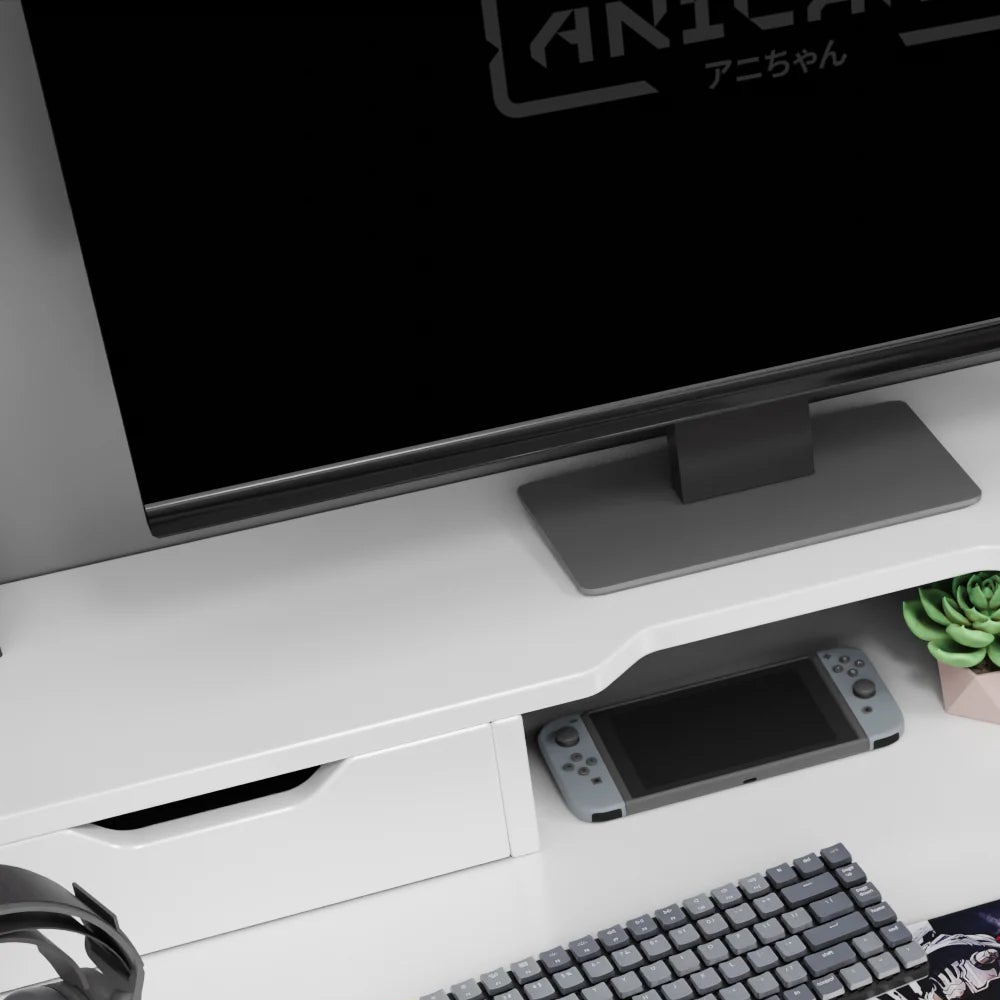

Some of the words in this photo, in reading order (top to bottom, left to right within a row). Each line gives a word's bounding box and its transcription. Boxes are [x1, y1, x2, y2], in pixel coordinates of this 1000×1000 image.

[704, 39, 847, 90] アニちゃん
